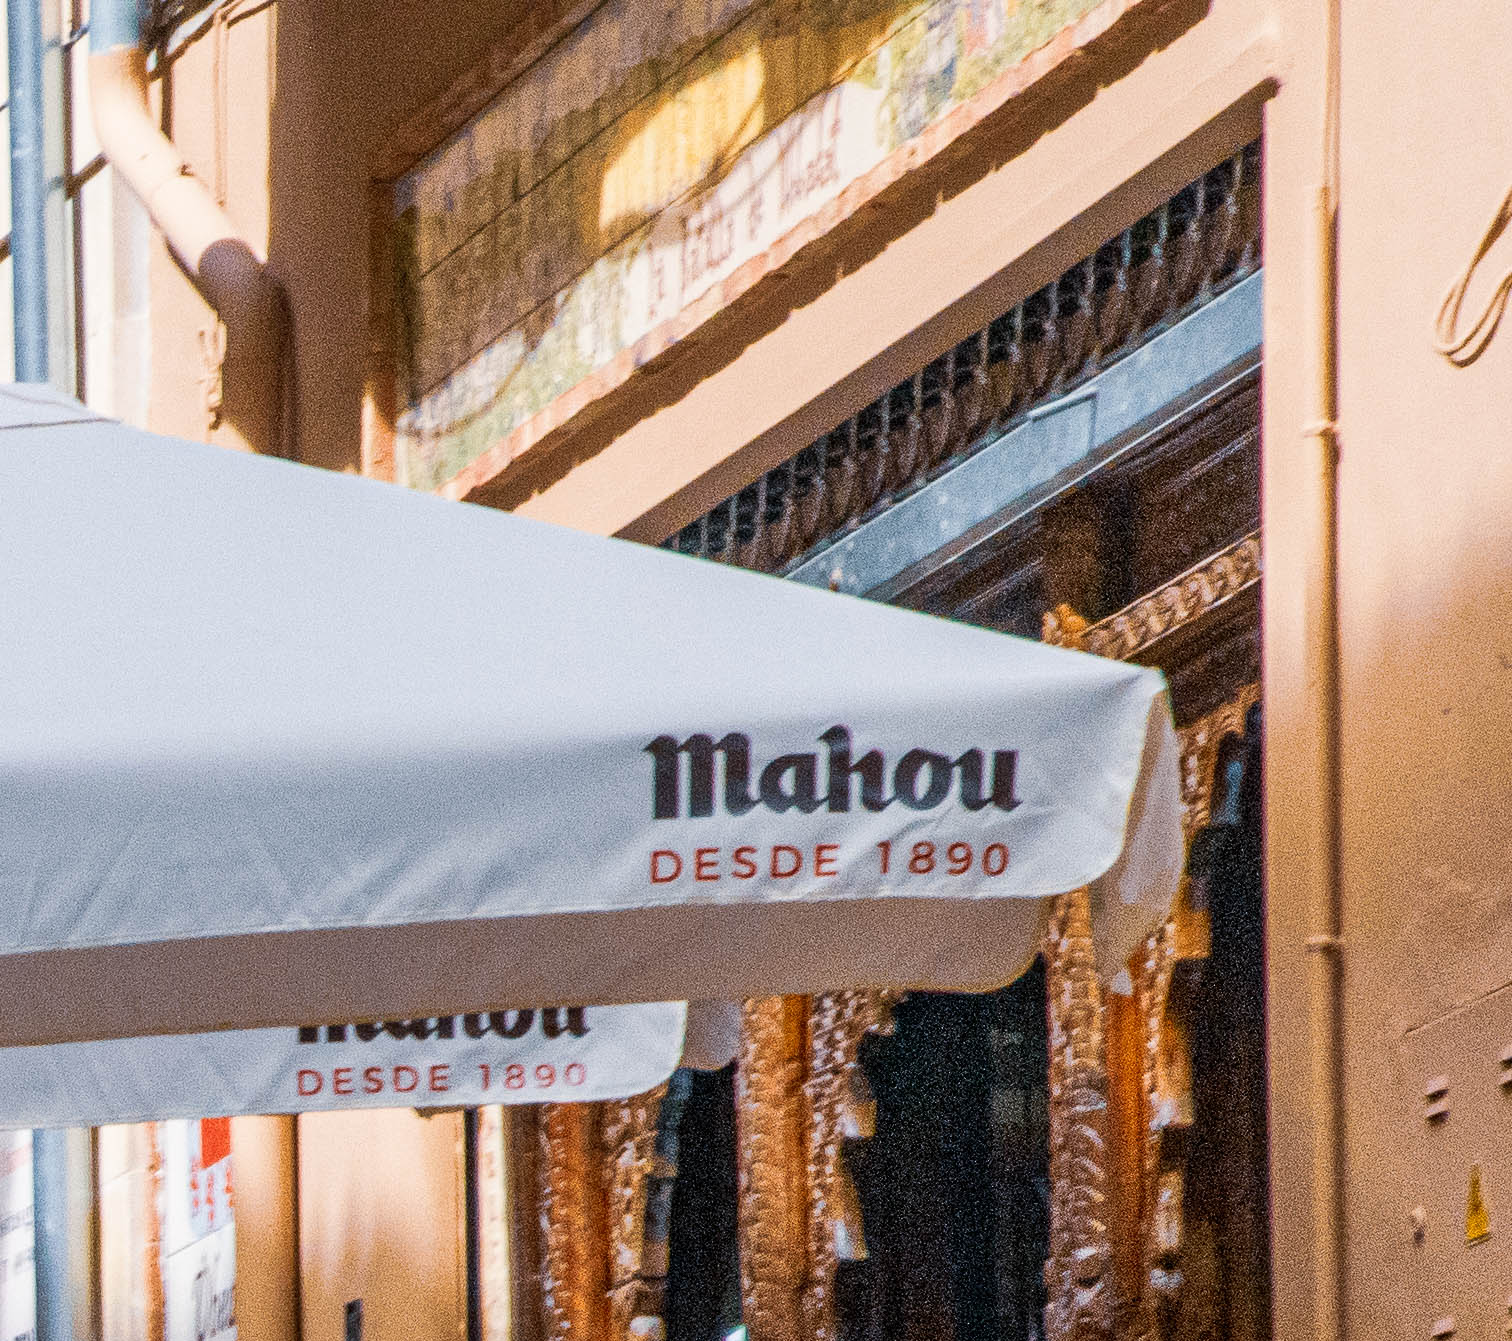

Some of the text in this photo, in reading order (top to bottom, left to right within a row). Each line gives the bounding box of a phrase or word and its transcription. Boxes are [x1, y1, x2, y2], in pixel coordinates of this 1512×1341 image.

[644, 725, 1022, 819] Mahou
[650, 840, 1010, 883] DESDE 1890
[297, 1063, 587, 1096] DESDE 1890
